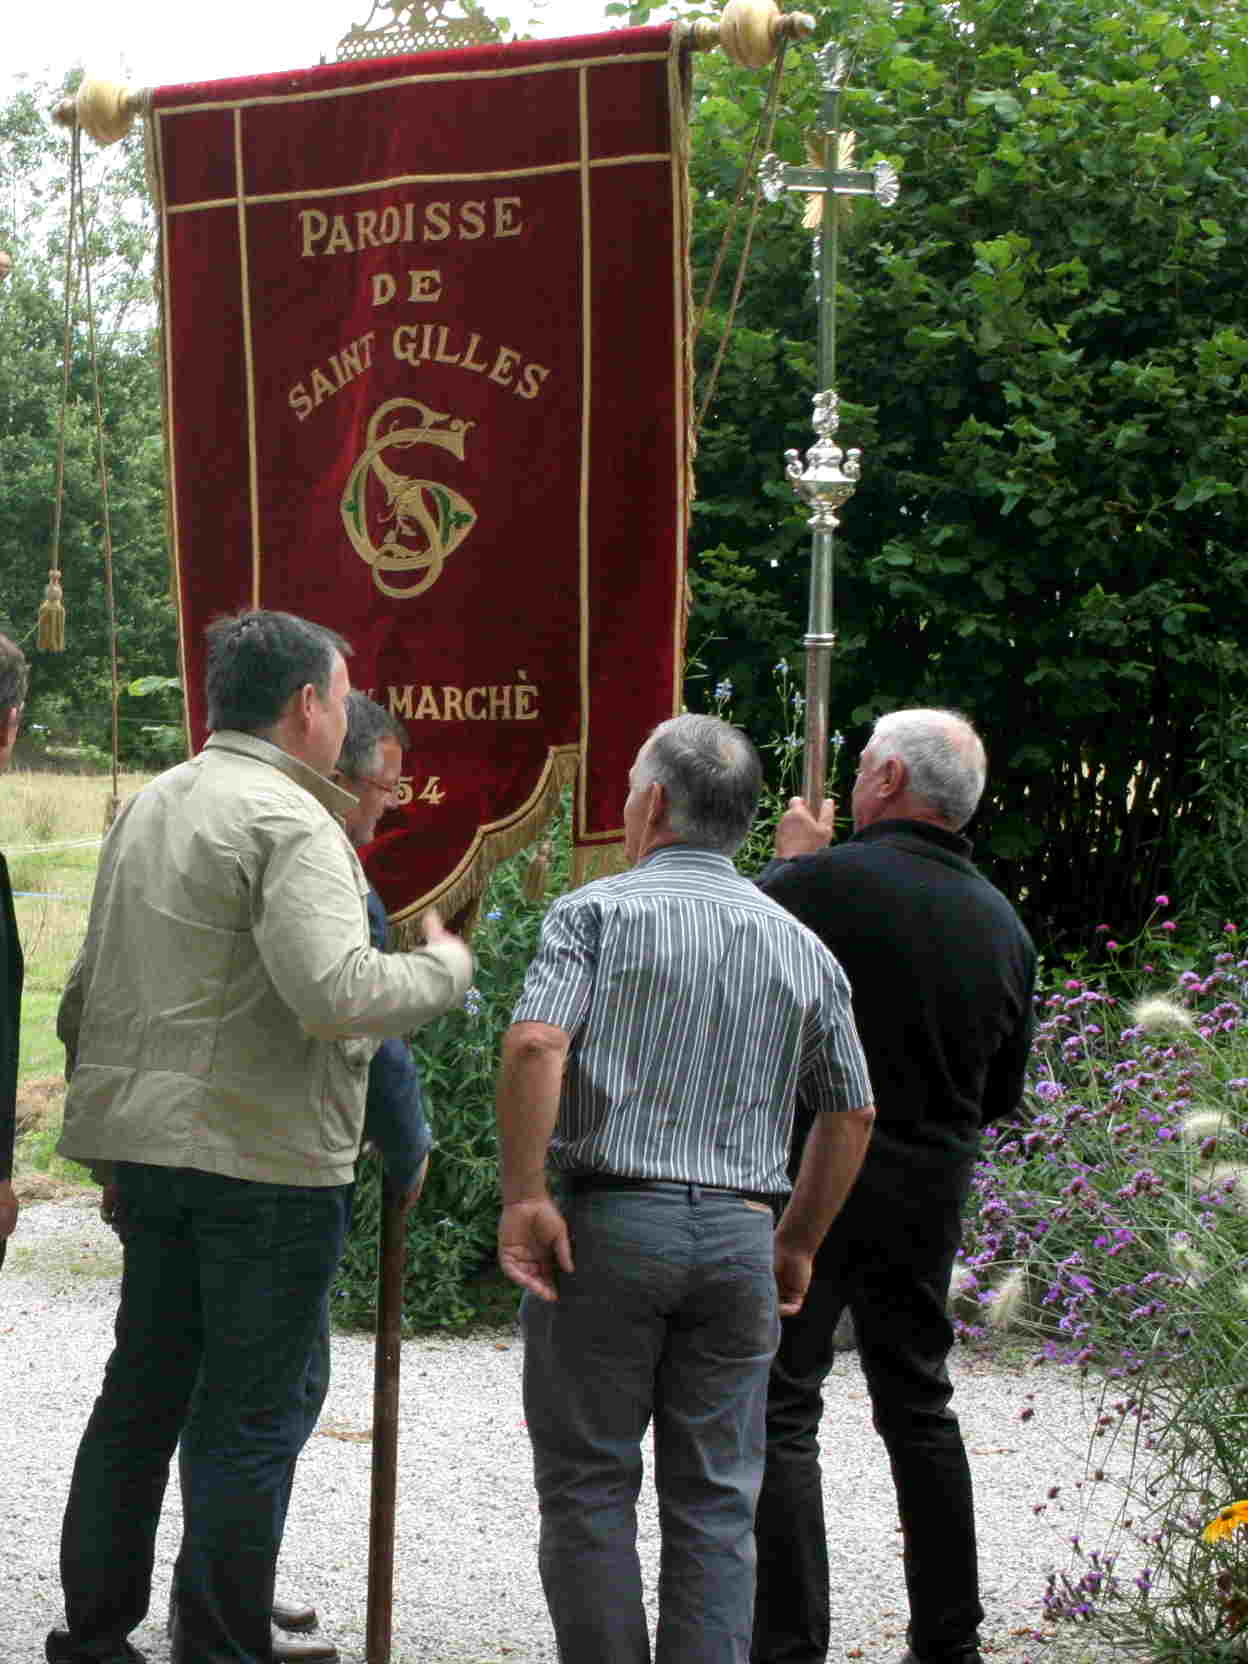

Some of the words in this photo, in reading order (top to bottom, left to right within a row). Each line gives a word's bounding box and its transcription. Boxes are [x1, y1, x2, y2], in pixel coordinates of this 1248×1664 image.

[298, 197, 523, 257] PAROISSE
[371, 269, 442, 306] DE
[288, 331, 376, 422] SAINT
[392, 323, 551, 400] GILLES
[399, 775, 446, 804] 54
